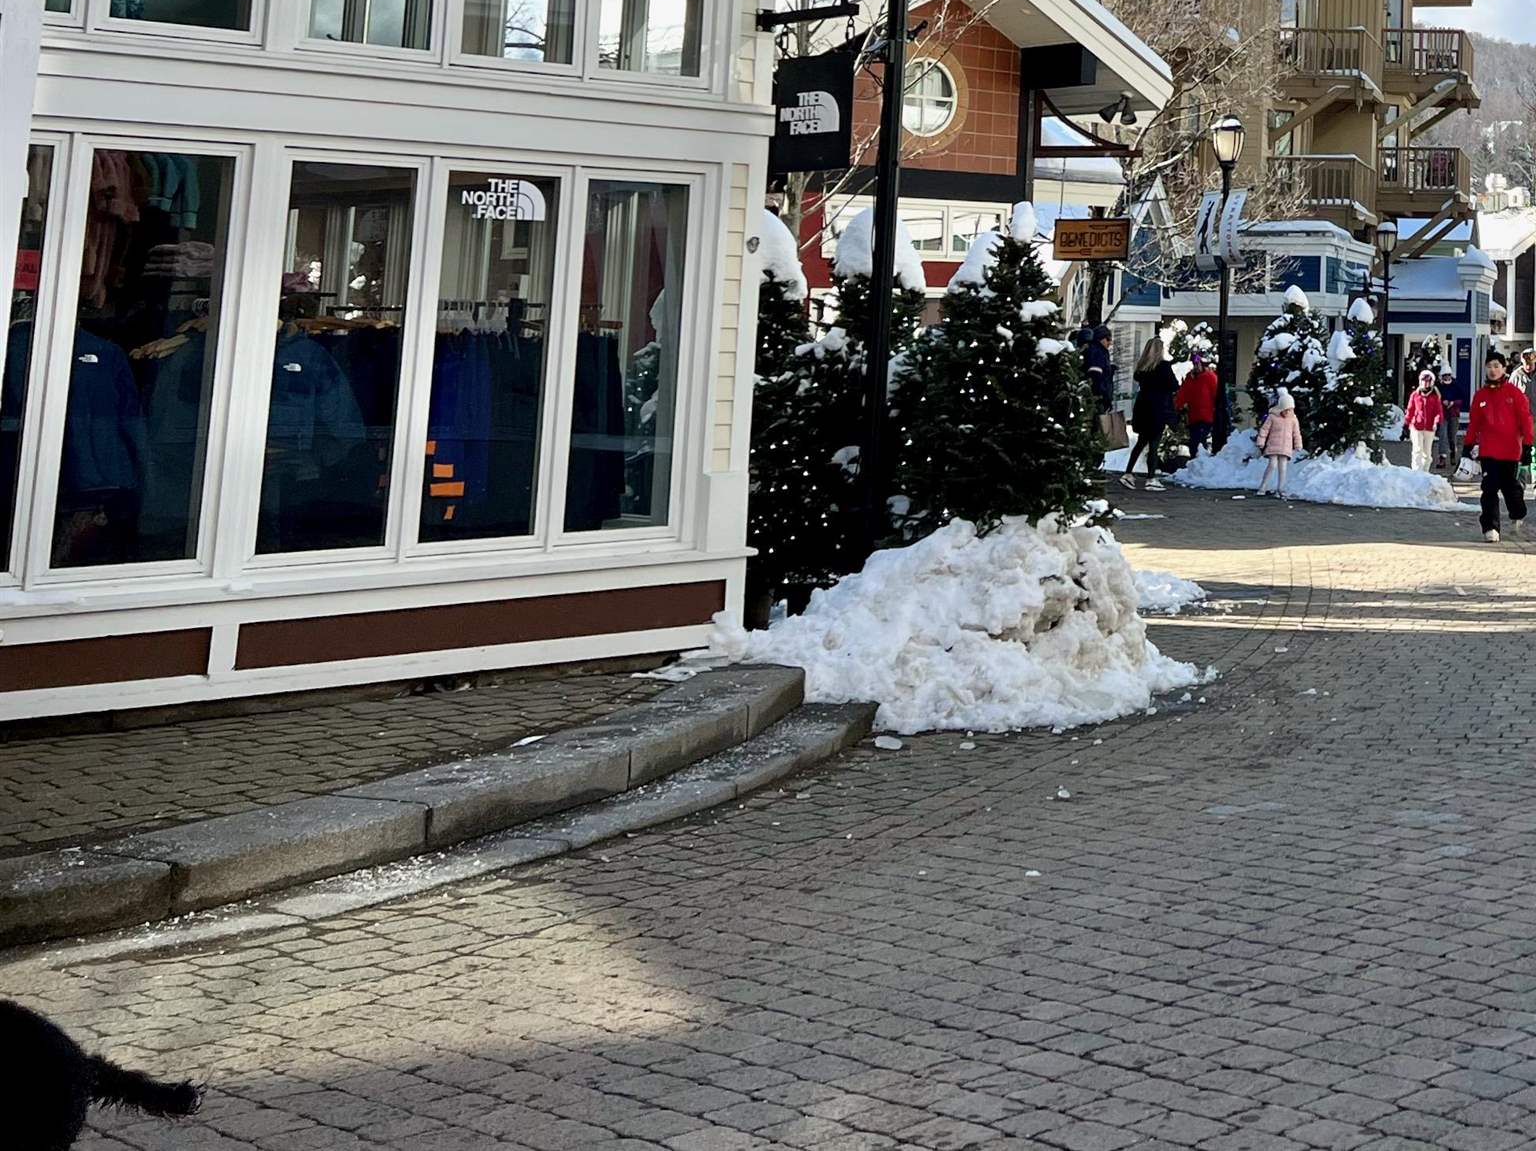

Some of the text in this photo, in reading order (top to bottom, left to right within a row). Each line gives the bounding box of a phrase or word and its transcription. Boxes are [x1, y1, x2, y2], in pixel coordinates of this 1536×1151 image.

[796, 92, 820, 106] THE
[780, 106, 820, 122] NORTH
[790, 119, 820, 135] FACE
[487, 178, 519, 193] THE
[462, 190, 517, 206] NORTH
[476, 205, 516, 220] FACE
[1060, 232, 1123, 247] BENEDICTS
